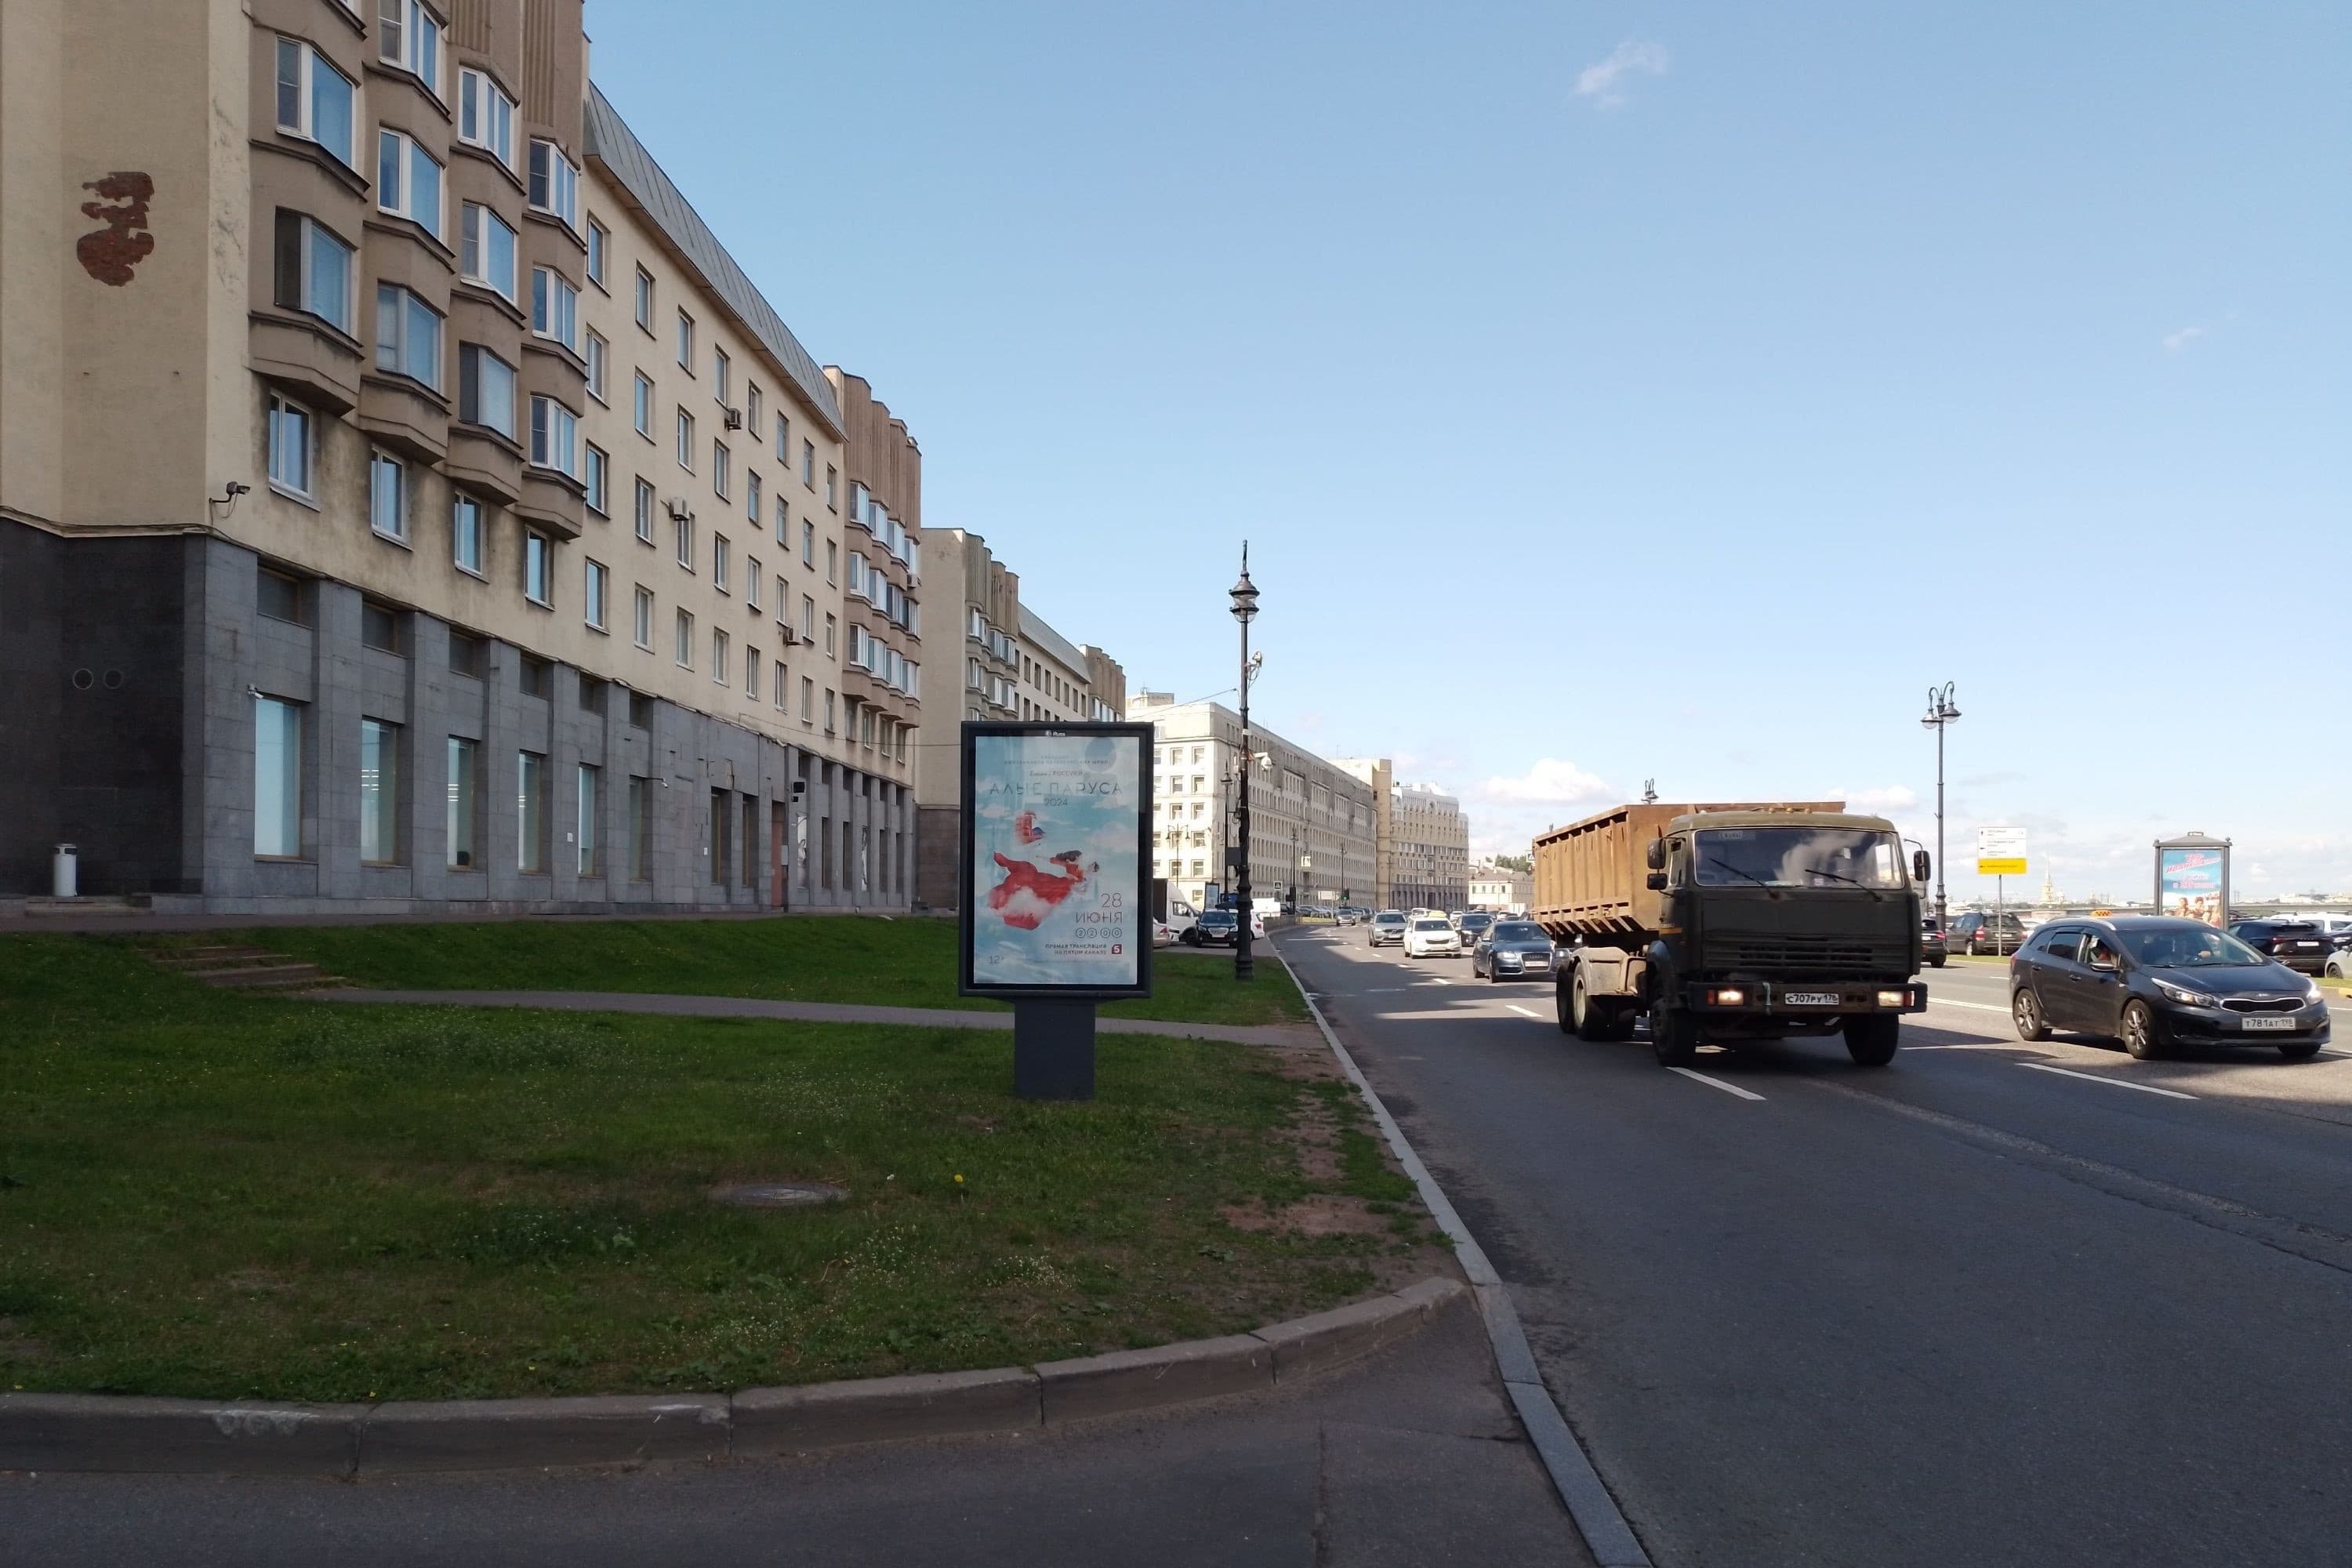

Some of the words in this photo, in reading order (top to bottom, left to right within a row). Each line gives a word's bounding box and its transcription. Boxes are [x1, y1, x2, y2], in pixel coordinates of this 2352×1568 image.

[989, 782, 1042, 796] АЛЫЕ
[1049, 782, 1123, 796] ПАРУСА
[1044, 798, 1069, 807] 2024
[1101, 892, 1123, 908] 28
[1075, 911, 1123, 924] ИЮНЯ
